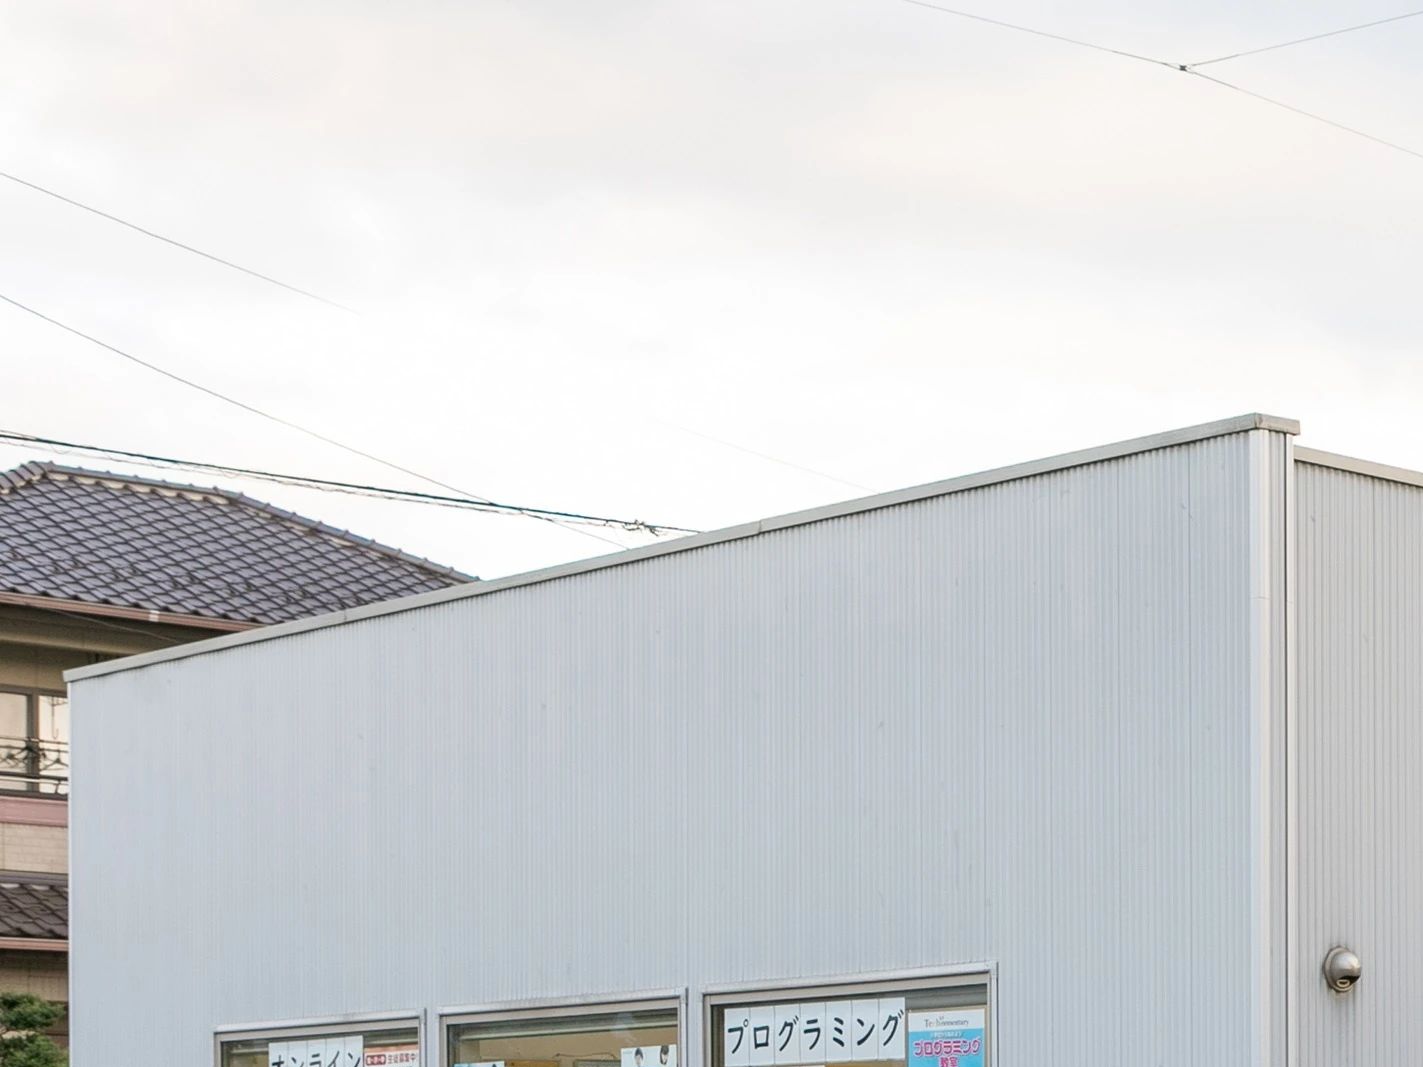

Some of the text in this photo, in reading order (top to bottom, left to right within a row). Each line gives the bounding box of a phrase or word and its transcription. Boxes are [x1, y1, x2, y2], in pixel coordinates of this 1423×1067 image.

[727, 1009, 904, 1054] プログラミング
[914, 1036, 981, 1057] プログラミング
